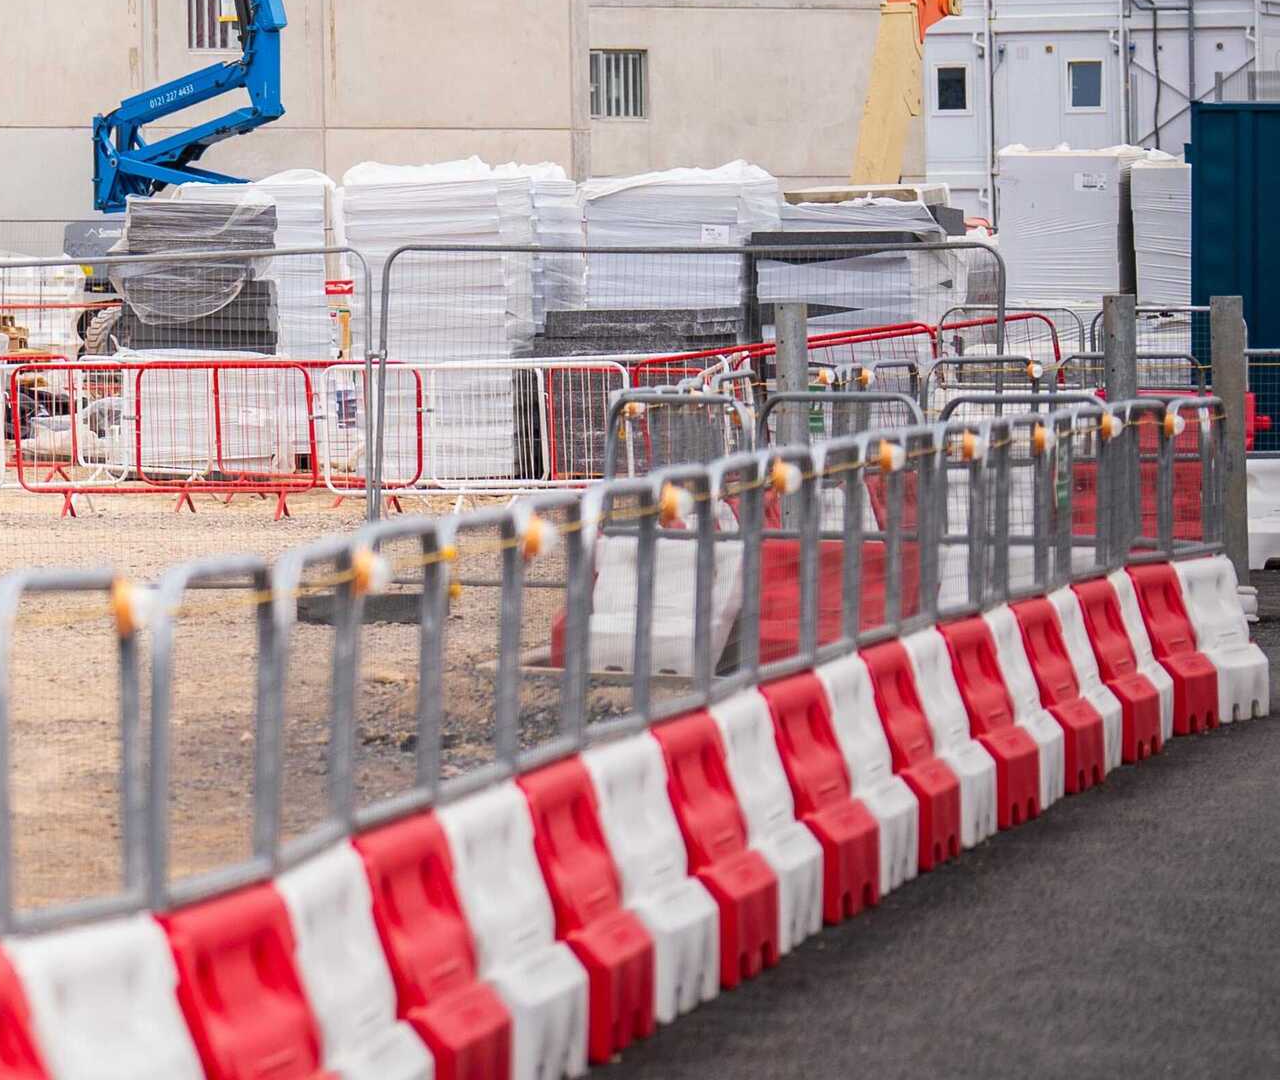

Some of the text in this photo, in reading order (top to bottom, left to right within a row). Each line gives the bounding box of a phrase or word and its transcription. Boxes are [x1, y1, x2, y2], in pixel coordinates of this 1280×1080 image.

[149, 83, 194, 109] 0121 227 4433
